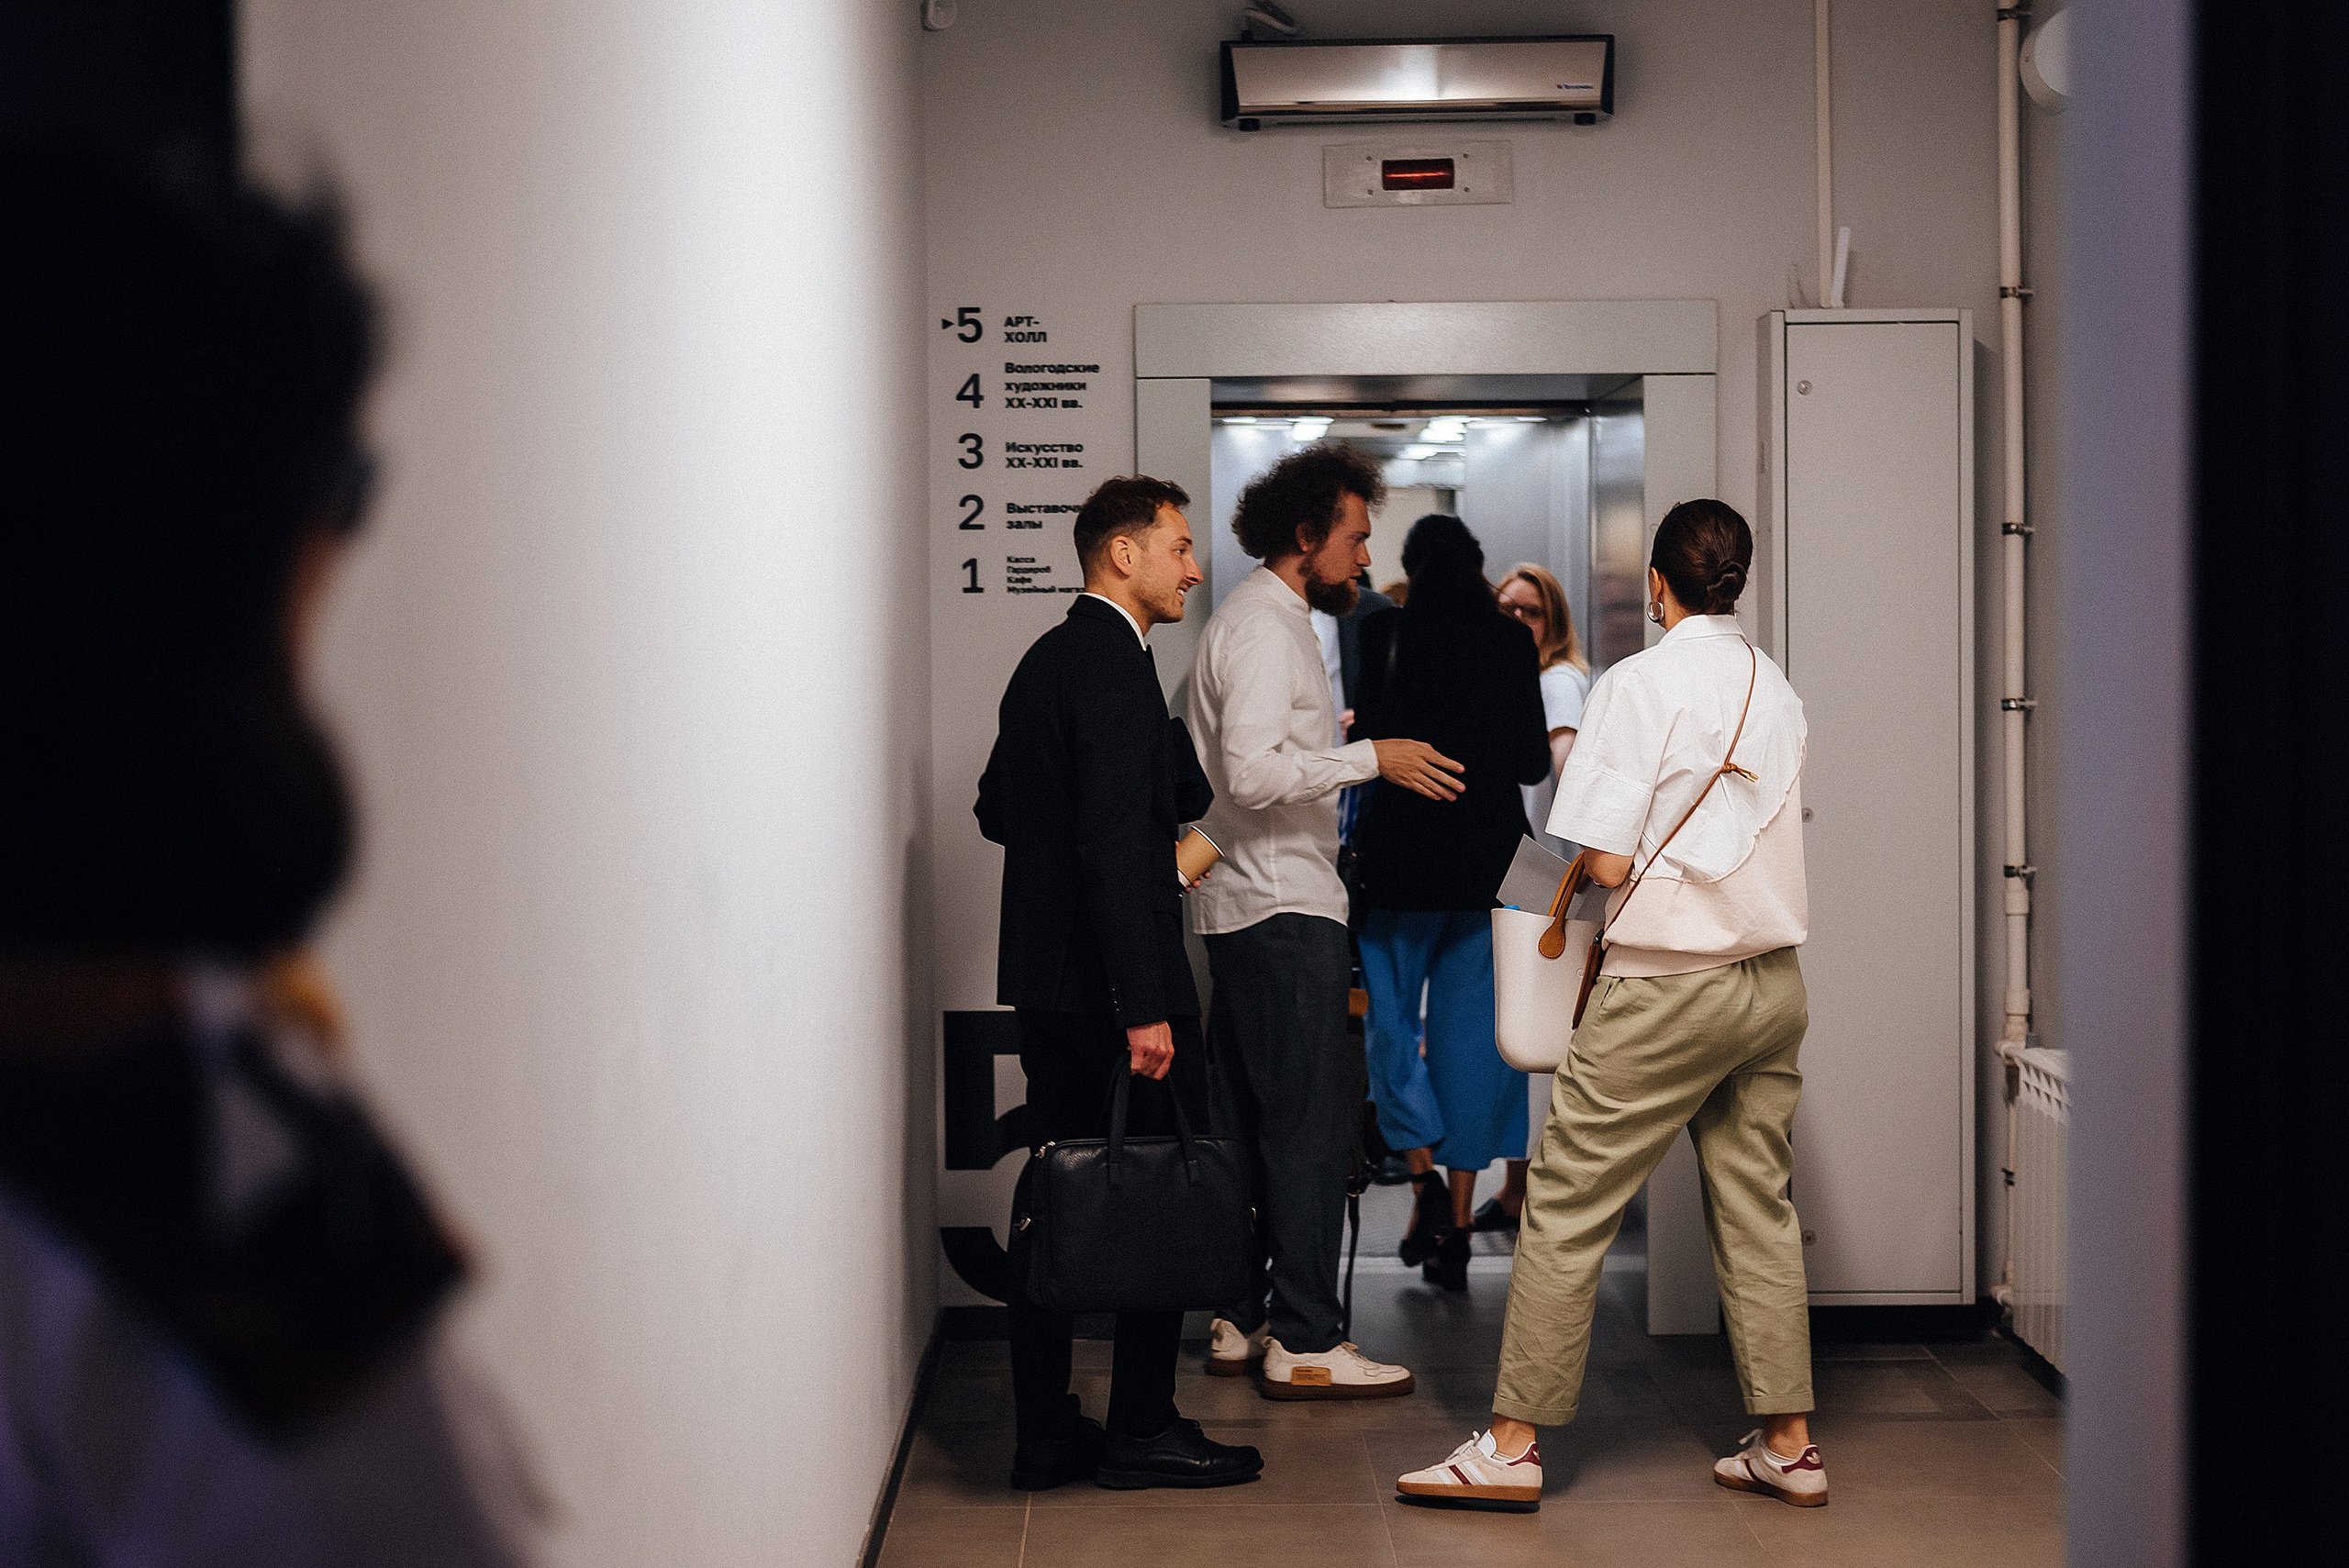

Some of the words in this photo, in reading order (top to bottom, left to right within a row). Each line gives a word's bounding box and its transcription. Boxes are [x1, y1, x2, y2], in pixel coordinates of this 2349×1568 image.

[957, 306, 984, 344] 5
[1003, 316, 1041, 328] АРТ-
[1003, 330, 1048, 343] ХОЛЛ
[1005, 361, 1100, 375] Вологодские
[955, 373, 985, 409] 4
[1005, 382, 1087, 395] художники
[957, 432, 985, 470] 3
[1005, 441, 1085, 455] Искусство
[958, 495, 985, 531] 2
[1006, 520, 1043, 530] залы
[962, 558, 985, 595] 1
[1007, 576, 1033, 584] Кафе
